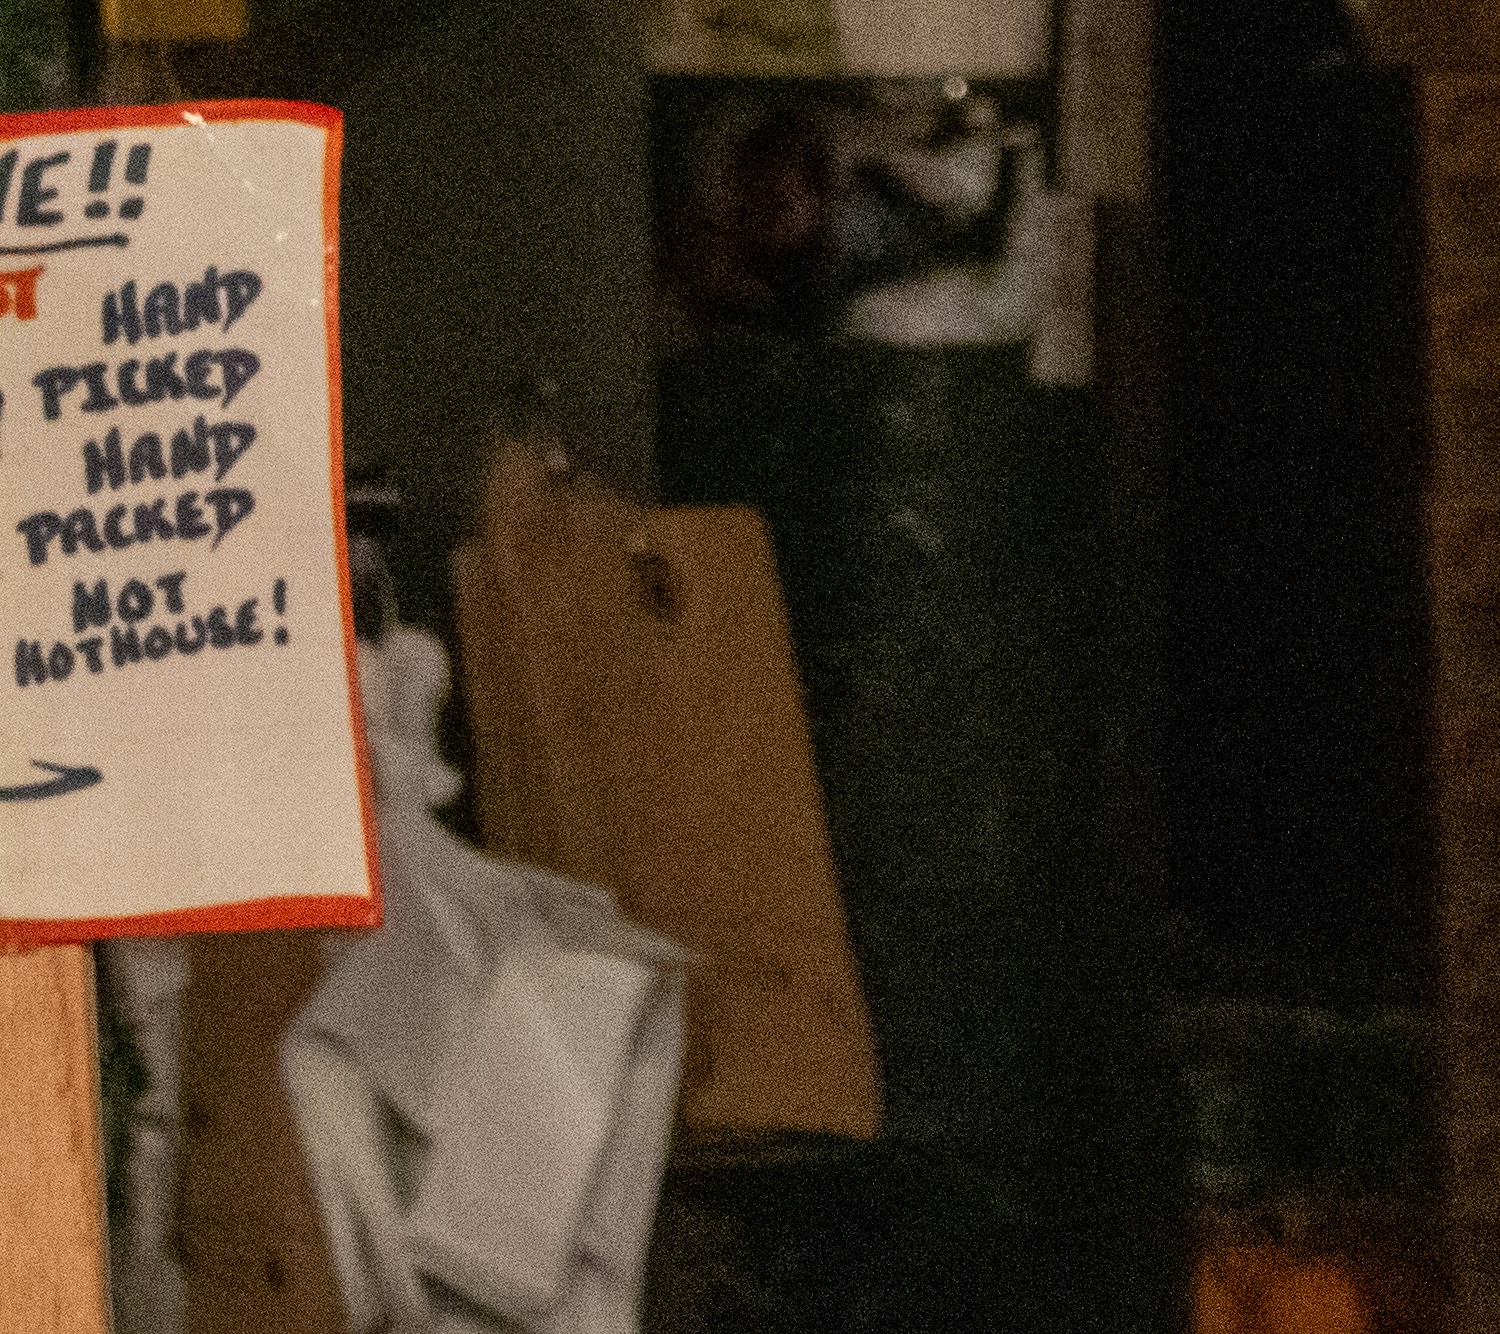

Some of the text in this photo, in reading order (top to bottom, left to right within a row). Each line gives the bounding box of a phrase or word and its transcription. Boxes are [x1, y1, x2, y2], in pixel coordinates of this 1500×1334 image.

[102, 265, 262, 347] HAND
[33, 348, 261, 421] PICKED
[82, 412, 257, 495] HAND
[17, 487, 256, 569] PACKED
[72, 570, 190, 635] NOT
